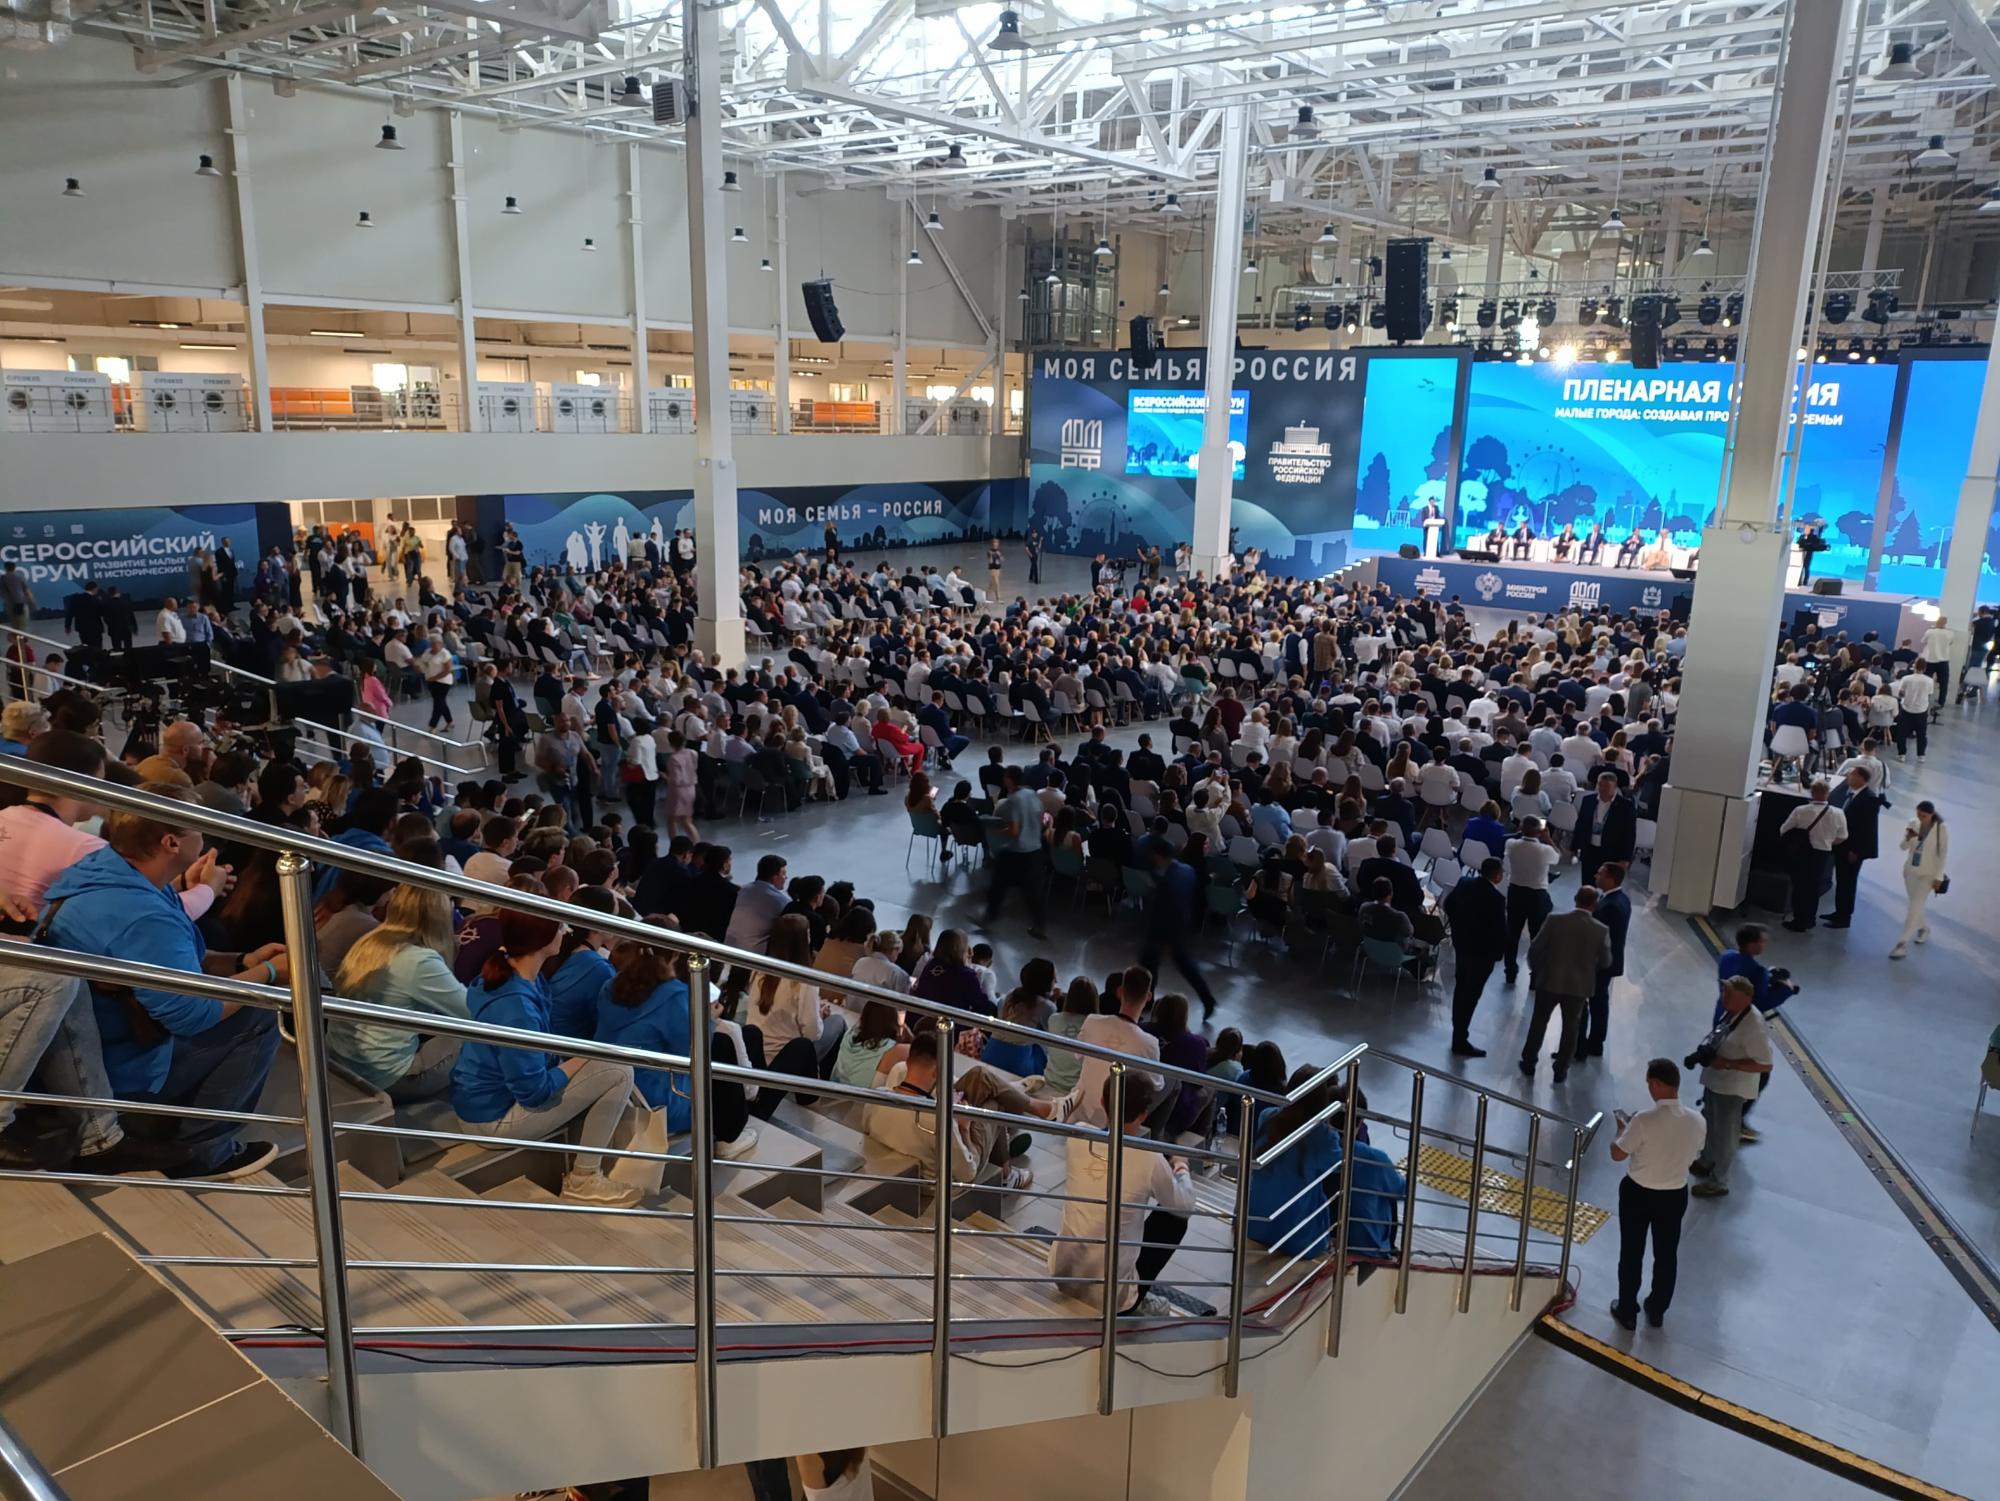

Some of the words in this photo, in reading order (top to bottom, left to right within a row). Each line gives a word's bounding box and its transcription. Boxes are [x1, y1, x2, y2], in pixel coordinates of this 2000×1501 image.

[1043, 358, 1095, 379] МОЯ
[1109, 357, 1201, 381] СЕМЬЯ
[1231, 356, 1357, 381] РОССИЯ
[1562, 378, 1721, 403] ПЛЕНАРНАЯ
[1554, 407, 1594, 419] МАЛЫЕ
[1595, 408, 1641, 421] ГОРОДА:
[1642, 409, 1701, 422] СОЗДАВАЯ
[1062, 418, 1102, 448] ДОМ
[1060, 453, 1101, 471] РФ
[1268, 457, 1331, 468] ПРАВИТЕЛЬСТВО
[1273, 466, 1325, 476] РОССИЙСКОЙ
[1275, 474, 1321, 484] ФЕДЕРАЦИИ
[759, 507, 796, 525] МОЯ
[804, 504, 861, 522] СЕМЬЯ
[882, 499, 942, 518] РОССИЯ
[0, 531, 216, 562] СЕРОССИЙСКИЙ
[93, 559, 147, 570] РАЗВИТИЕ
[149, 557, 186, 567] МАЛЫХ
[0, 562, 89, 583] ОРУМ
[94, 570, 103, 579] И
[104, 565, 184, 578] ИСТОРИЧЕСКИХ
[1506, 590, 1536, 599] РОССИИ
[1507, 584, 1547, 594] МИНСТРОЙ
